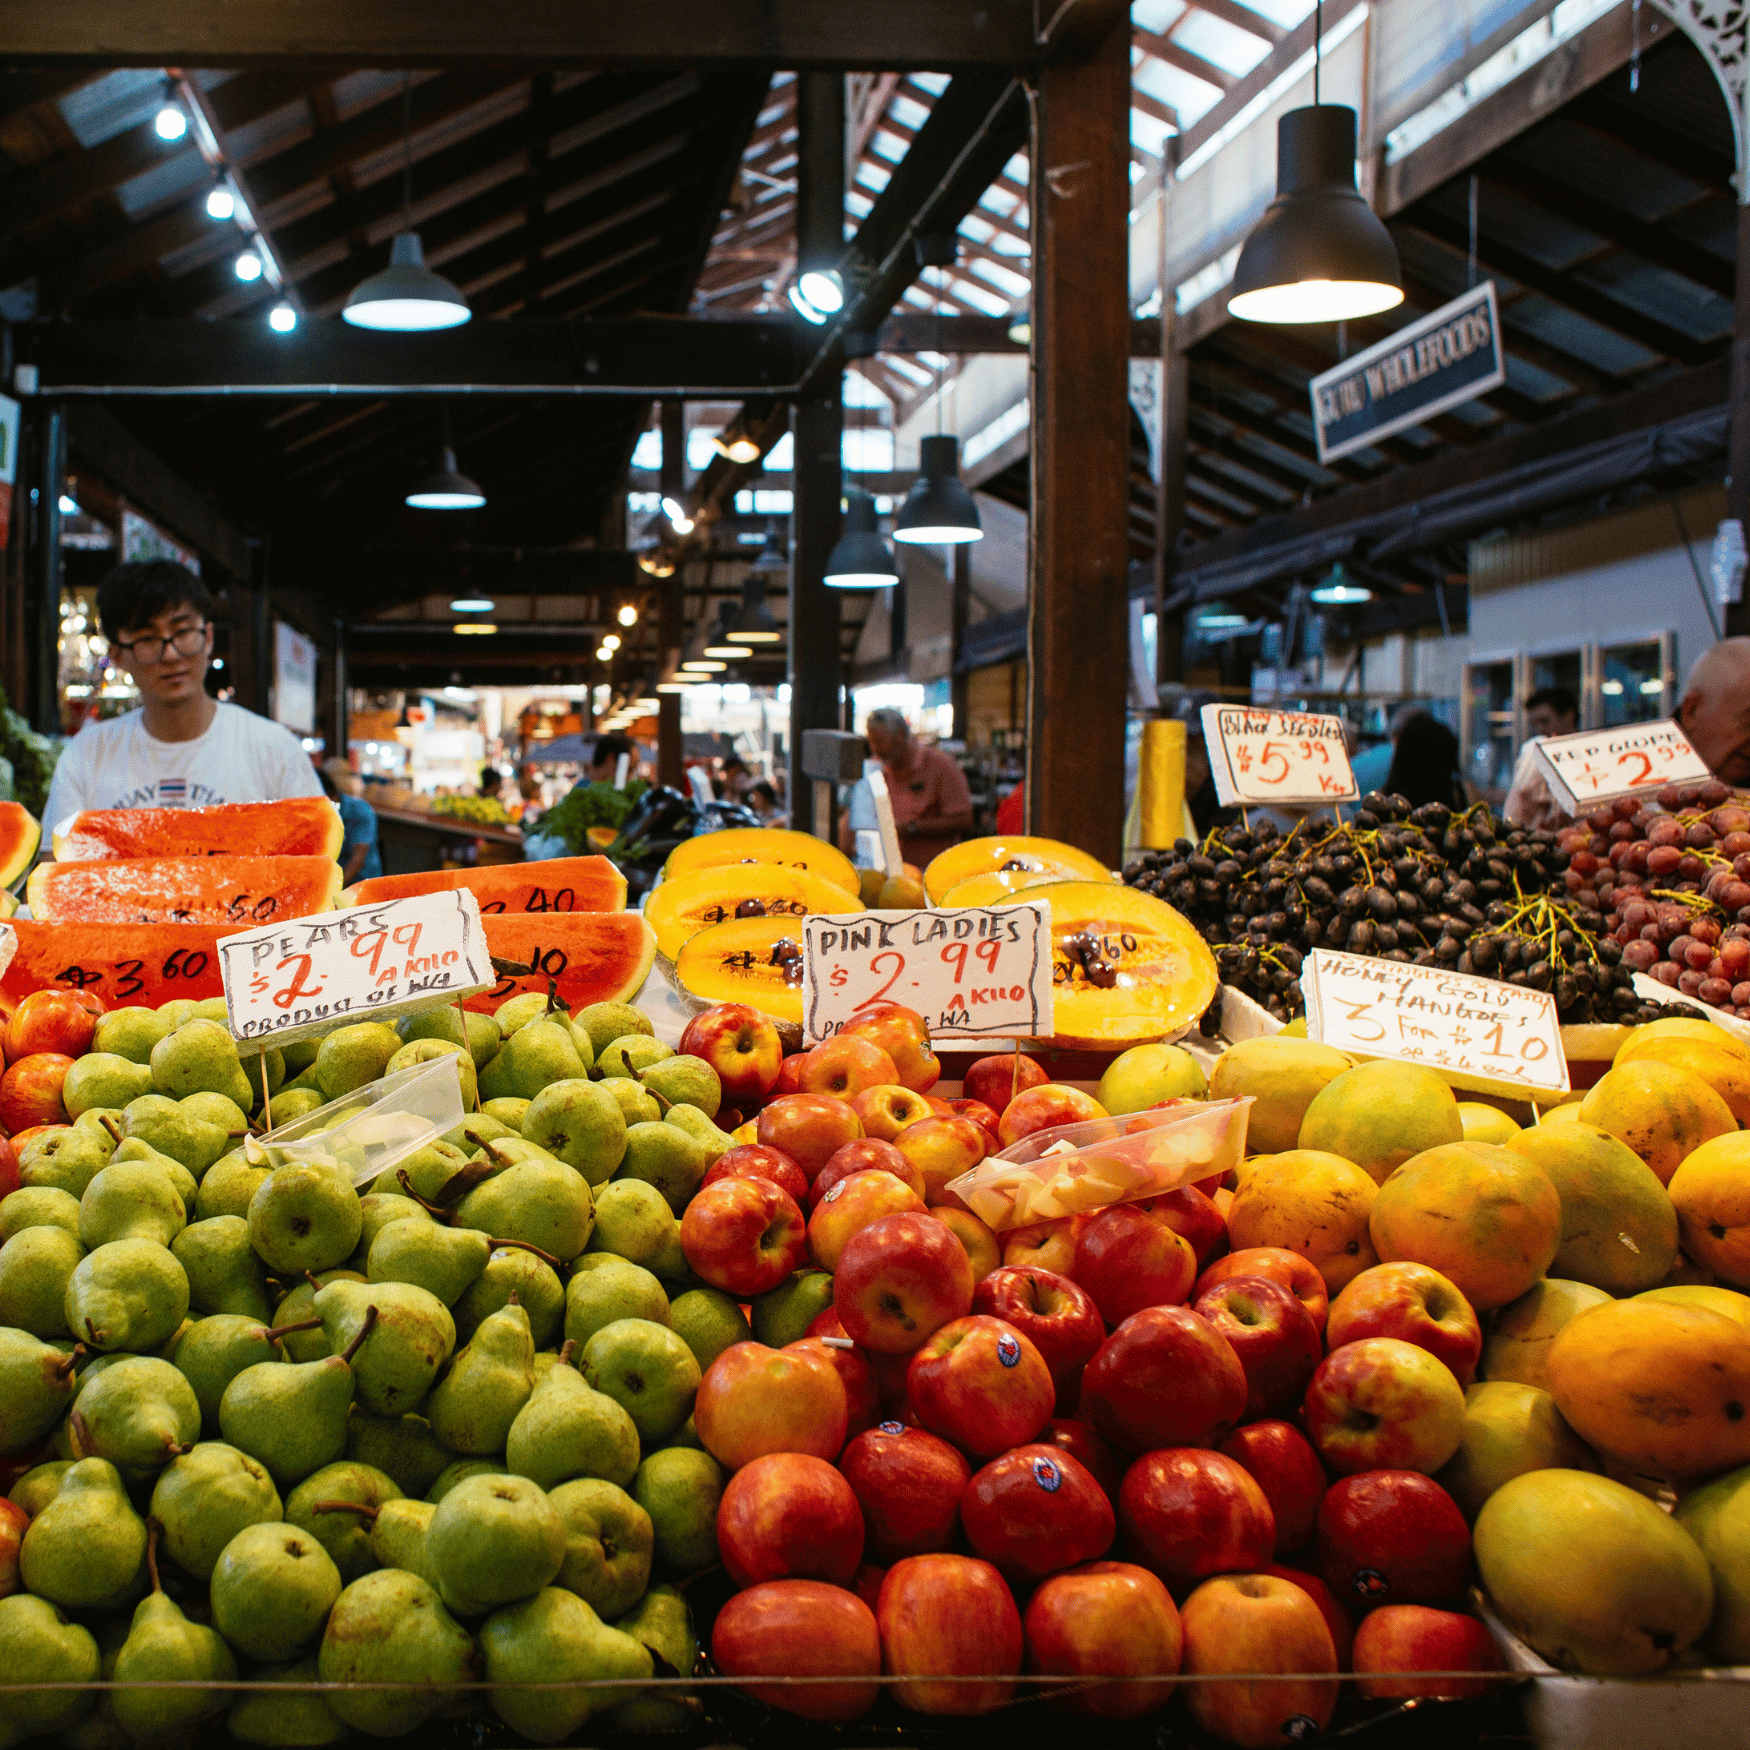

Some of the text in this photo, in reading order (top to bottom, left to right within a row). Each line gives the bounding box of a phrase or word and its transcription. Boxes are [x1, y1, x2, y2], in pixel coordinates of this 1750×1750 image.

[251, 914, 389, 968] PEARS
[820, 916, 1021, 957] PINK LADIES
[249, 922, 423, 1010] $2.99
[375, 949, 459, 987] A KILO
[829, 940, 1002, 1013] $2.99
[1321, 958, 1510, 1007] HONEY GOLD
[366, 984, 399, 1005] OF
[947, 984, 1026, 1010] A KILO
[939, 1009, 972, 1028] WA
[1332, 995, 1386, 1042] 3
[1447, 1022, 1550, 1062] $10
